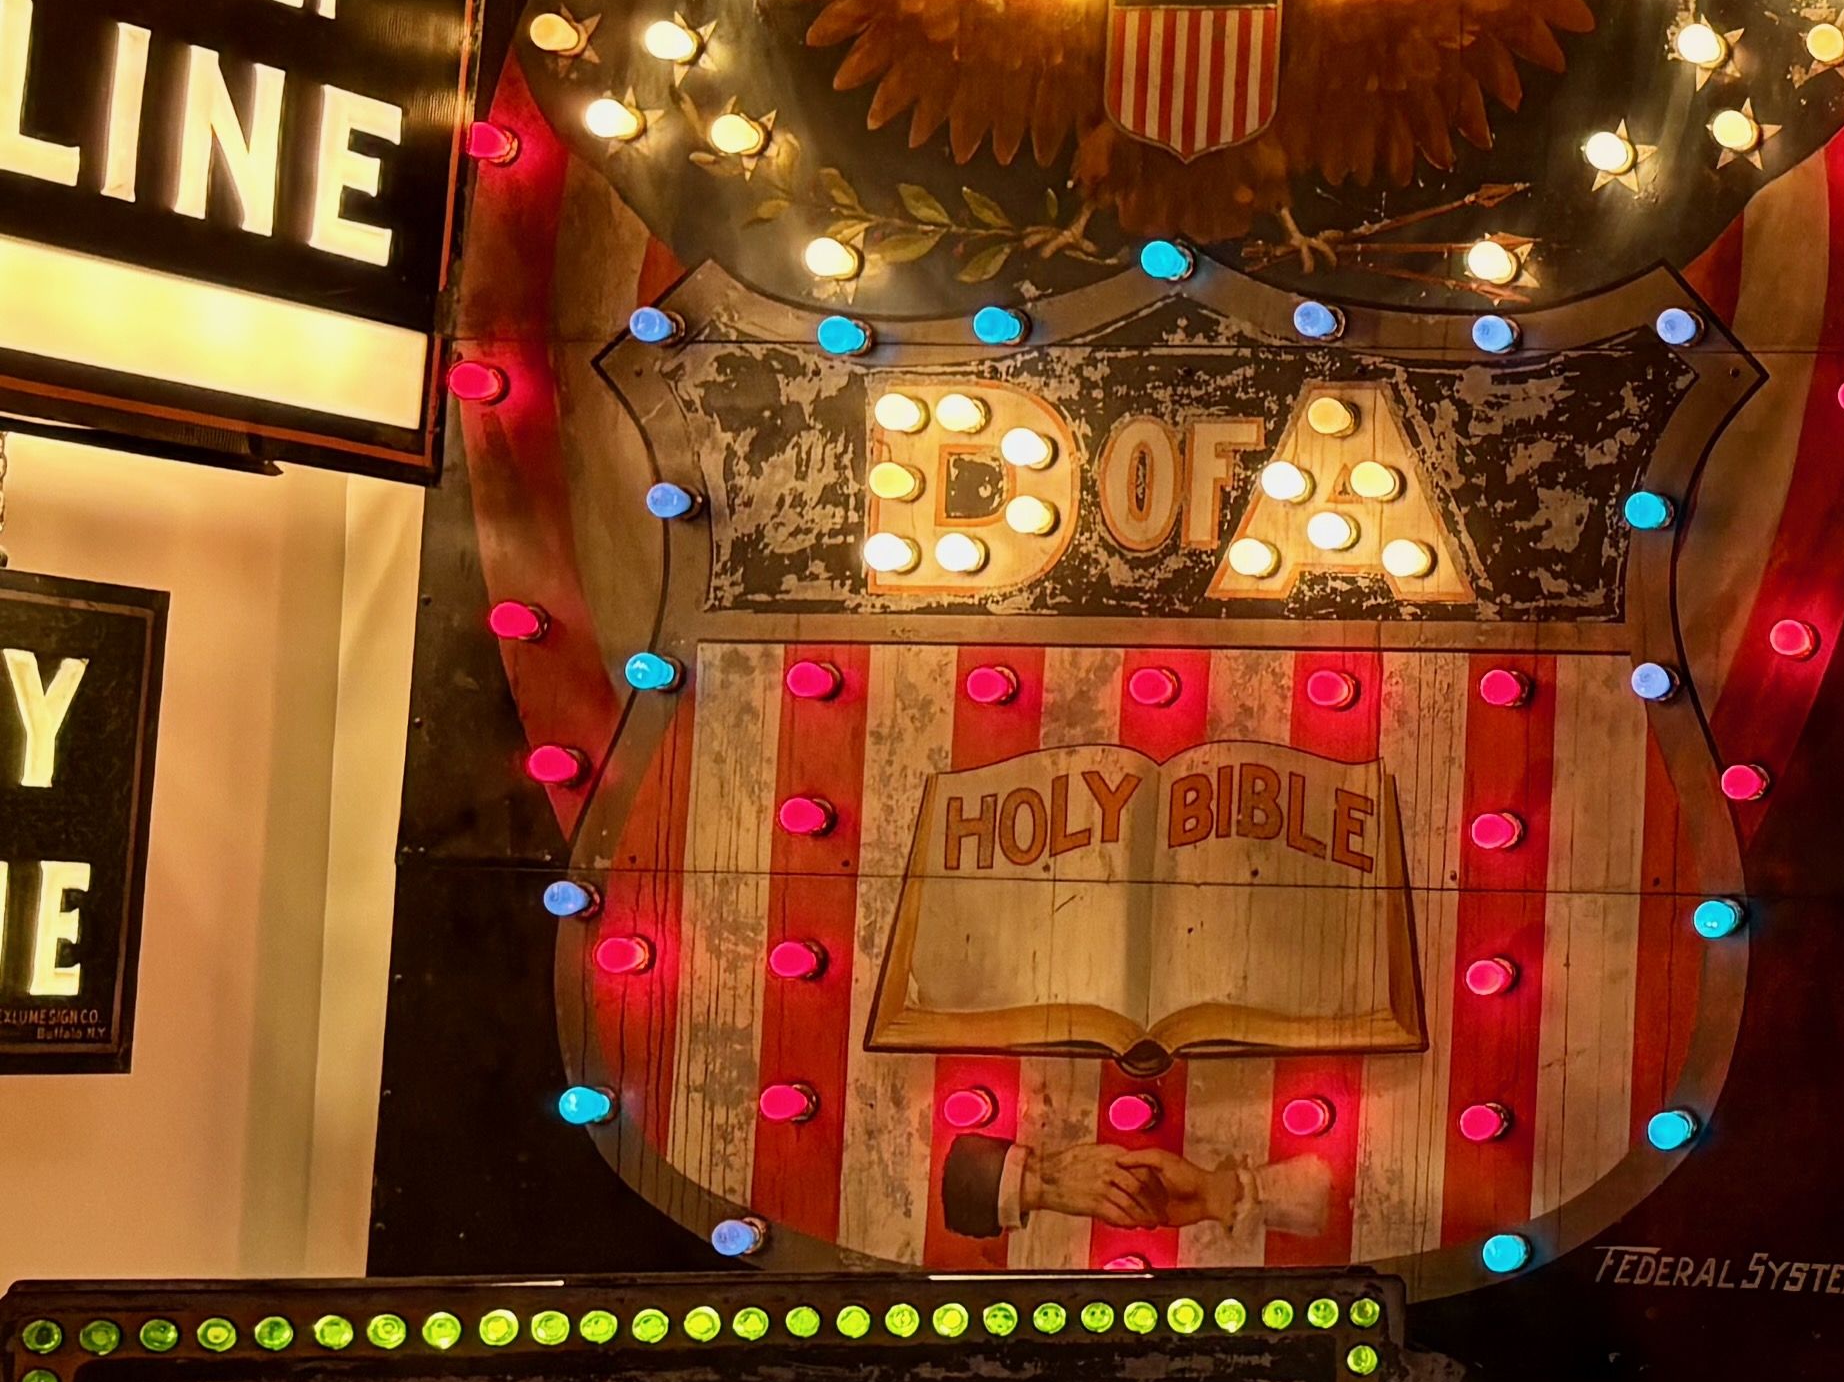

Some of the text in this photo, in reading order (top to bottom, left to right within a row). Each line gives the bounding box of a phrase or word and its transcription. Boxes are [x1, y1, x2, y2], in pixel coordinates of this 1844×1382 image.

[1205, 381, 1476, 603] A
[3, 647, 89, 788] Y
[943, 761, 1376, 876] HOLY BIBLE
[1594, 1246, 1735, 1289] FEDERAL
